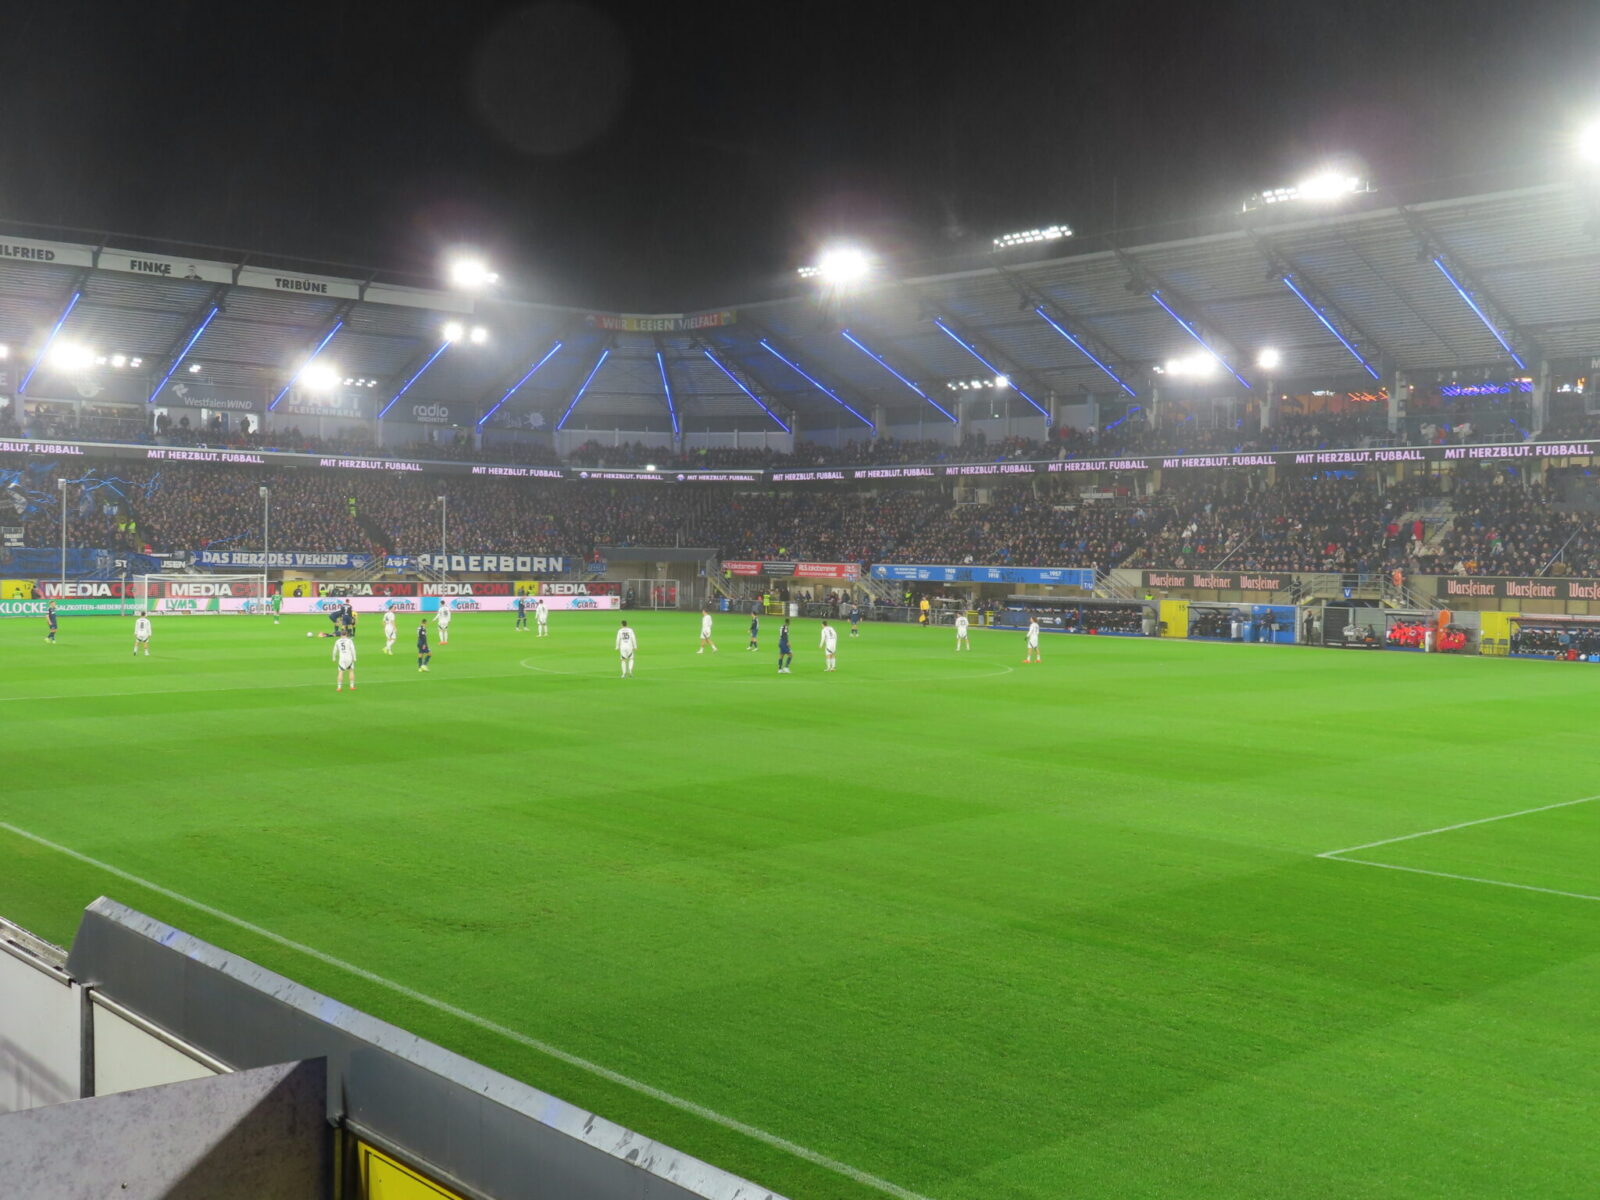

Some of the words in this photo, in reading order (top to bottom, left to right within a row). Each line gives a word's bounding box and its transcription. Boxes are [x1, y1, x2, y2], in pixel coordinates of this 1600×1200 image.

[130, 260, 171, 274] FINKE
[275, 278, 328, 293] TRIBÜNE
[148, 450, 165, 459] MIT
[168, 451, 220, 462] HERZBLUT.
[1296, 453, 1314, 464] MIT
[1317, 451, 1372, 463] HERZBLUT.
[1445, 448, 1466, 459] MIT
[1469, 446, 1532, 458] HERZBLUT.
[320, 459, 335, 467] MIT
[338, 460, 383, 470] HERZBLUT.
[1048, 463, 1063, 472] MIT
[1065, 461, 1107, 471] HERZBLUT.
[1163, 458, 1179, 468] MIT
[1182, 456, 1230, 467] HERZBLUT.
[472, 467, 486, 475] MIT
[488, 468, 528, 476] HERZBLUT.
[855, 470, 866, 479] MIT
[868, 469, 902, 478] HERZBLUT.
[946, 467, 959, 476] MIT
[961, 465, 999, 475] HERZBLUT.
[773, 473, 784, 481] MIT
[202, 551, 230, 563] DAS
[232, 553, 265, 565] HERZ
[268, 554, 293, 565] DES
[295, 554, 349, 566] VEREINS
[416, 553, 563, 572] PADERBORN
[1149, 573, 1185, 588] Warsteiner
[1193, 573, 1231, 589] Warsteiner
[1240, 575, 1280, 590] Warsteiner
[423, 583, 510, 595] MEDIACOM
[1344, 588, 1351, 597] V
[1447, 579, 1496, 596] Warsteiner
[1506, 580, 1557, 598] Warsteiner
[456, 602, 480, 610] GLANZ
[576, 601, 598, 609] GLANZ
[341, 642, 346, 651] 5
